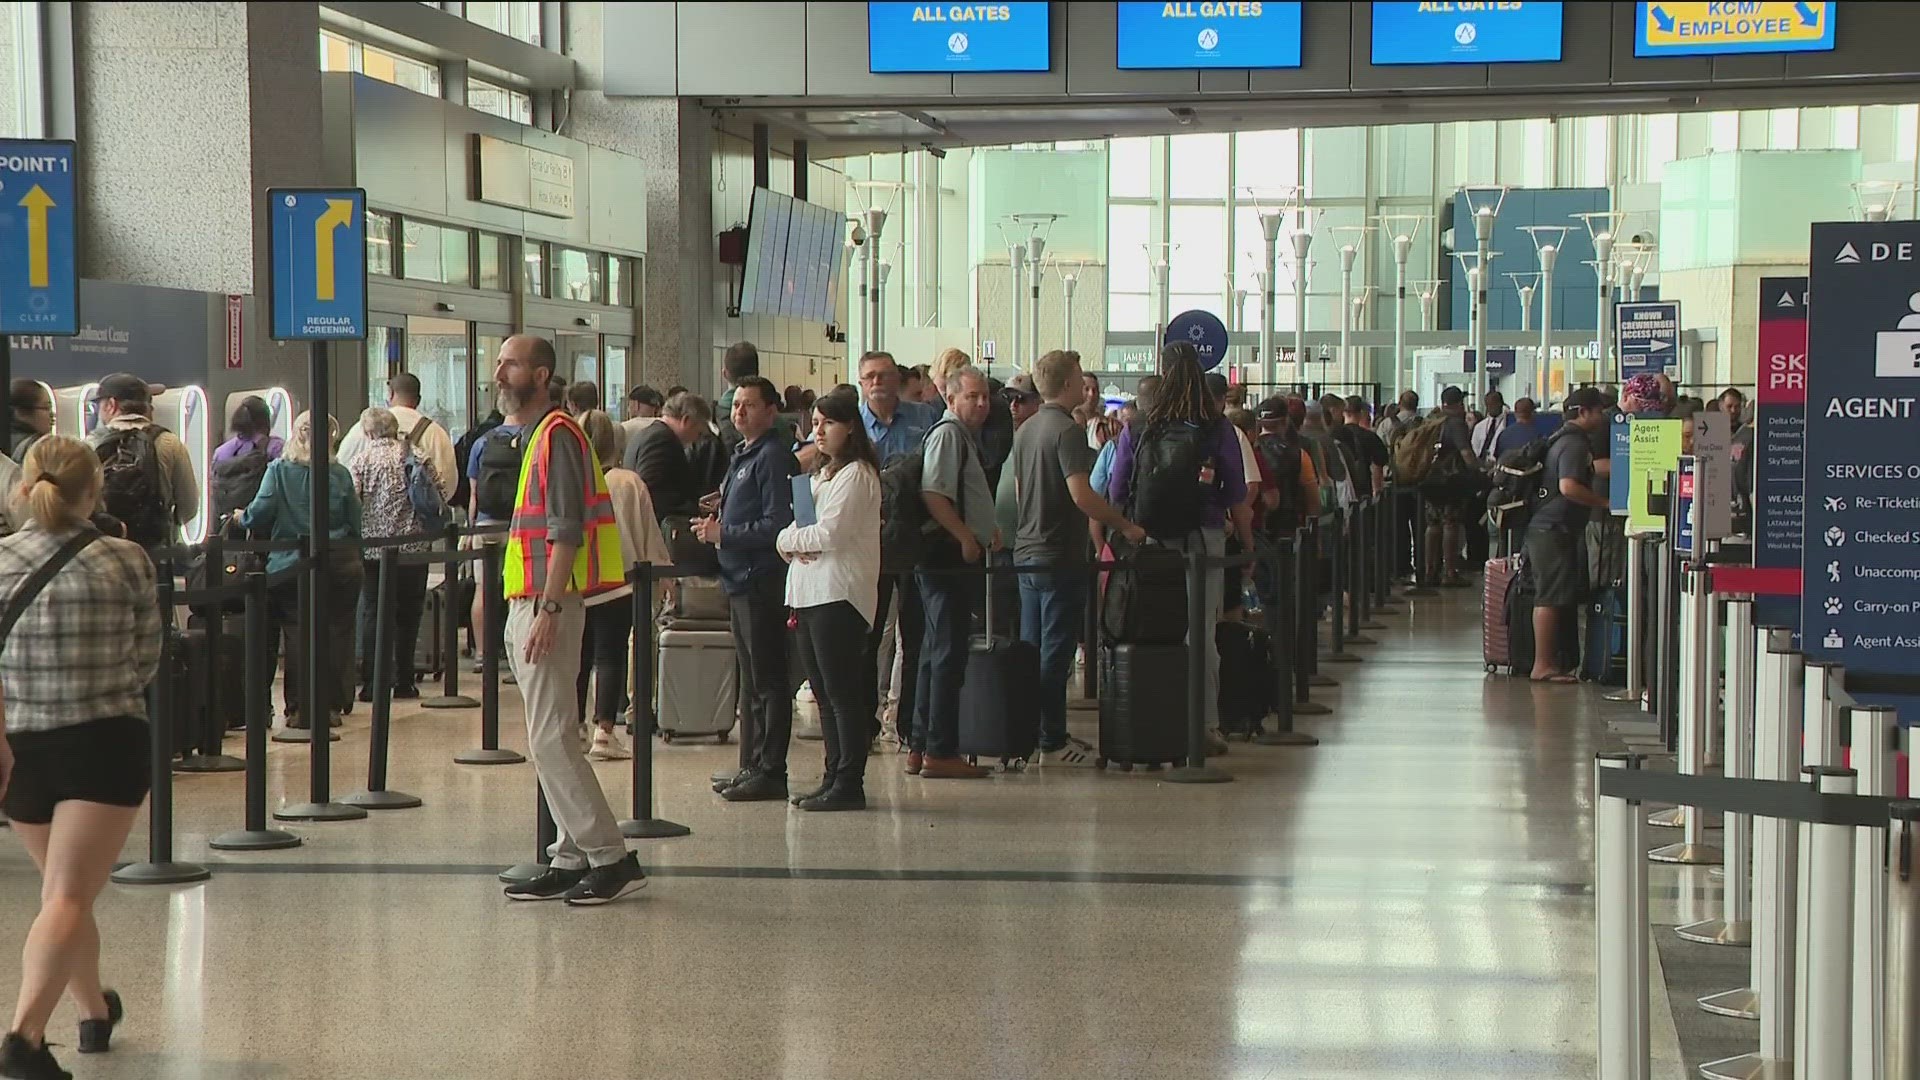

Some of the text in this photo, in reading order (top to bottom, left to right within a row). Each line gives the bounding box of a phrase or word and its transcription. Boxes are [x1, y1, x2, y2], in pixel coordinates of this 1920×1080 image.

[1162, 2, 1263, 17] ALL GATES
[1417, 2, 1523, 12] ALL GATES
[1708, 2, 1763, 16] KCM/
[912, 5, 1011, 22] ALL GATES
[1679, 18, 1791, 36] EMPLOYEE
[60, 157, 69, 173] 1
[20, 313, 57, 322] CLEAR
[307, 317, 351, 325] REGULAR
[1633, 311, 1663, 320] KNOWN
[302, 325, 356, 334] SCREENING
[1621, 320, 1675, 330] CREWMEMBER
[1622, 329, 1675, 339] ACCESS POINT
[1321, 343, 1329, 355] 2
[1123, 352, 1147, 361] JAMES
[1770, 373, 1804, 389] PR
[1825, 397, 1916, 418] AGENT
[1768, 417, 1804, 425] Delta One
[1634, 424, 1660, 434] Agent
[1634, 434, 1659, 443] Assist
[1826, 465, 1903, 478] SERVICES
[1768, 495, 1803, 503] WE ALSO
[1855, 496, 1920, 508] Re-Ticketi
[1855, 531, 1910, 543] Checked
[1854, 565, 1920, 580] Unaccomp
[1854, 600, 1909, 614] Carry-on
[1854, 635, 1920, 649] Agent Assi
